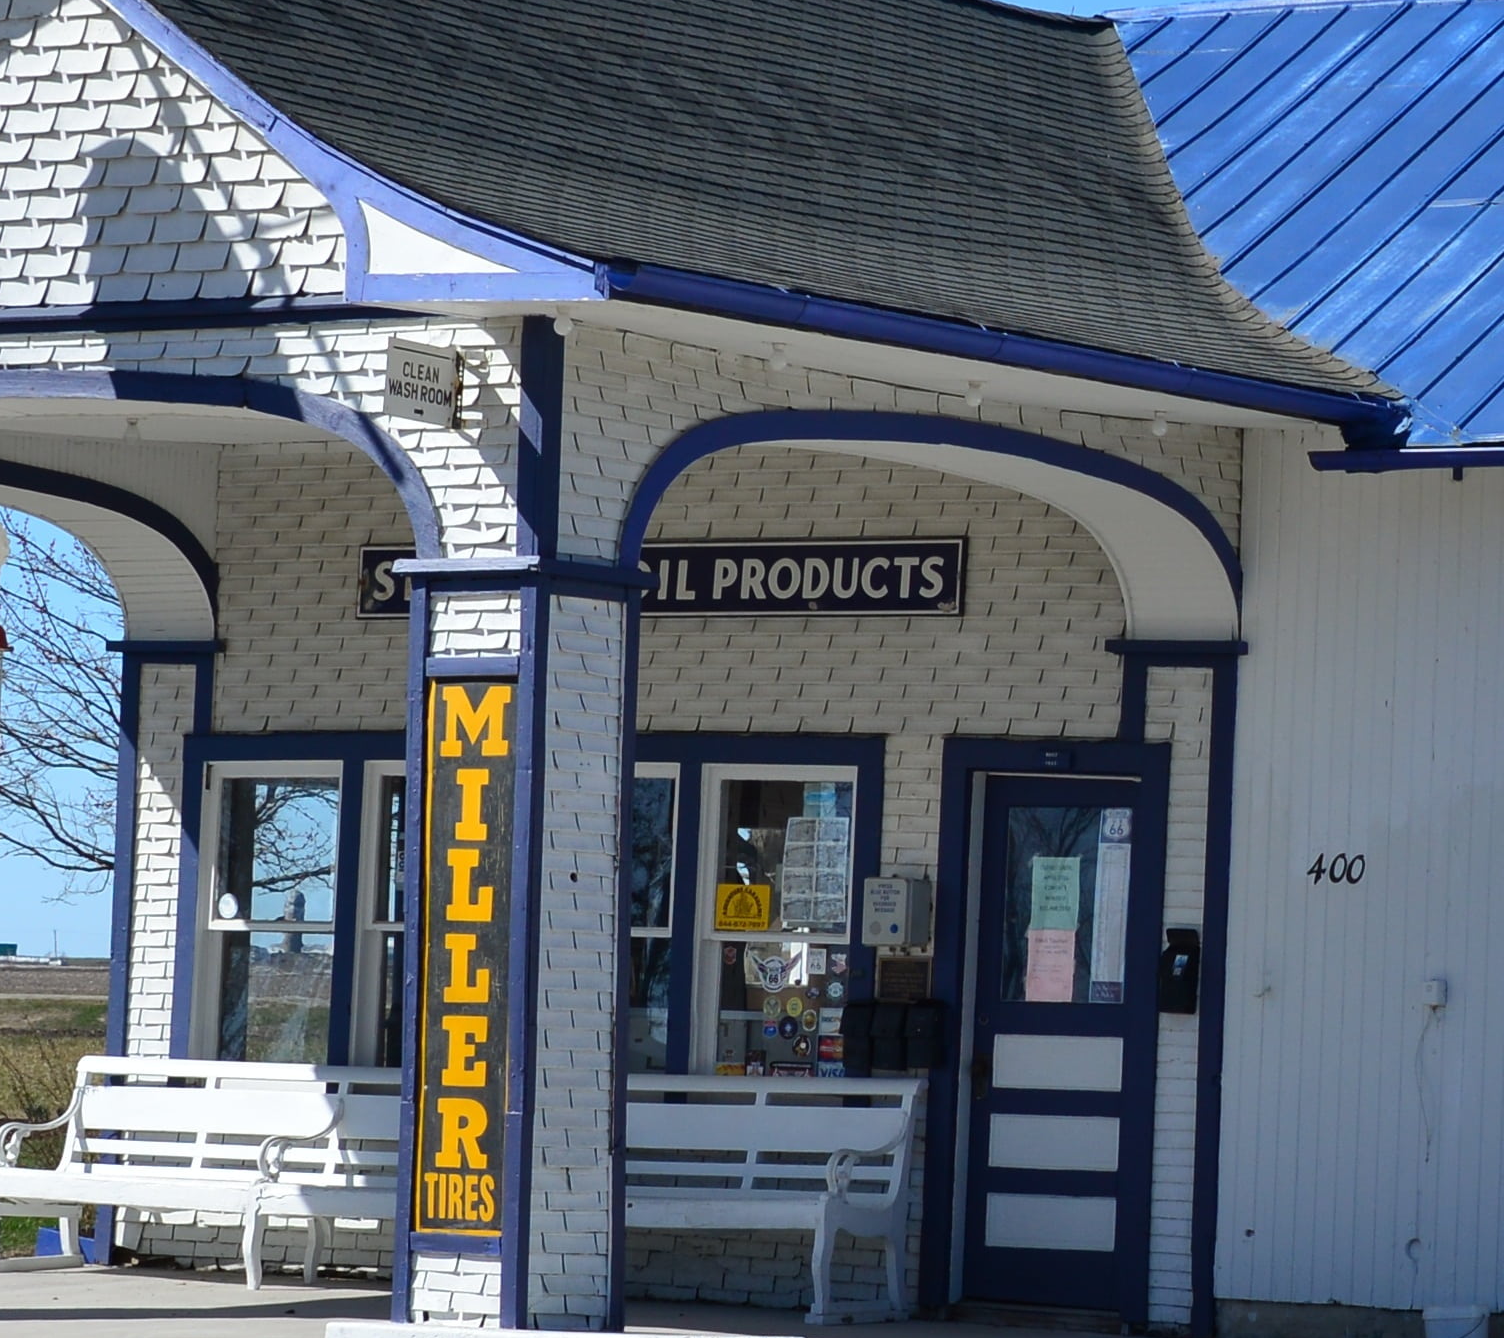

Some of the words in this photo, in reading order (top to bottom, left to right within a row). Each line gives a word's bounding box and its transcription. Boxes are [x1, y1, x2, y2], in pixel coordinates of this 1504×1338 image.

[402, 361, 440, 384] CLEAN
[712, 556, 945, 599] PRODUCTS
[1306, 852, 1366, 885] 400
[434, 685, 511, 1168] MILLER
[424, 1172, 496, 1223] TIRES
